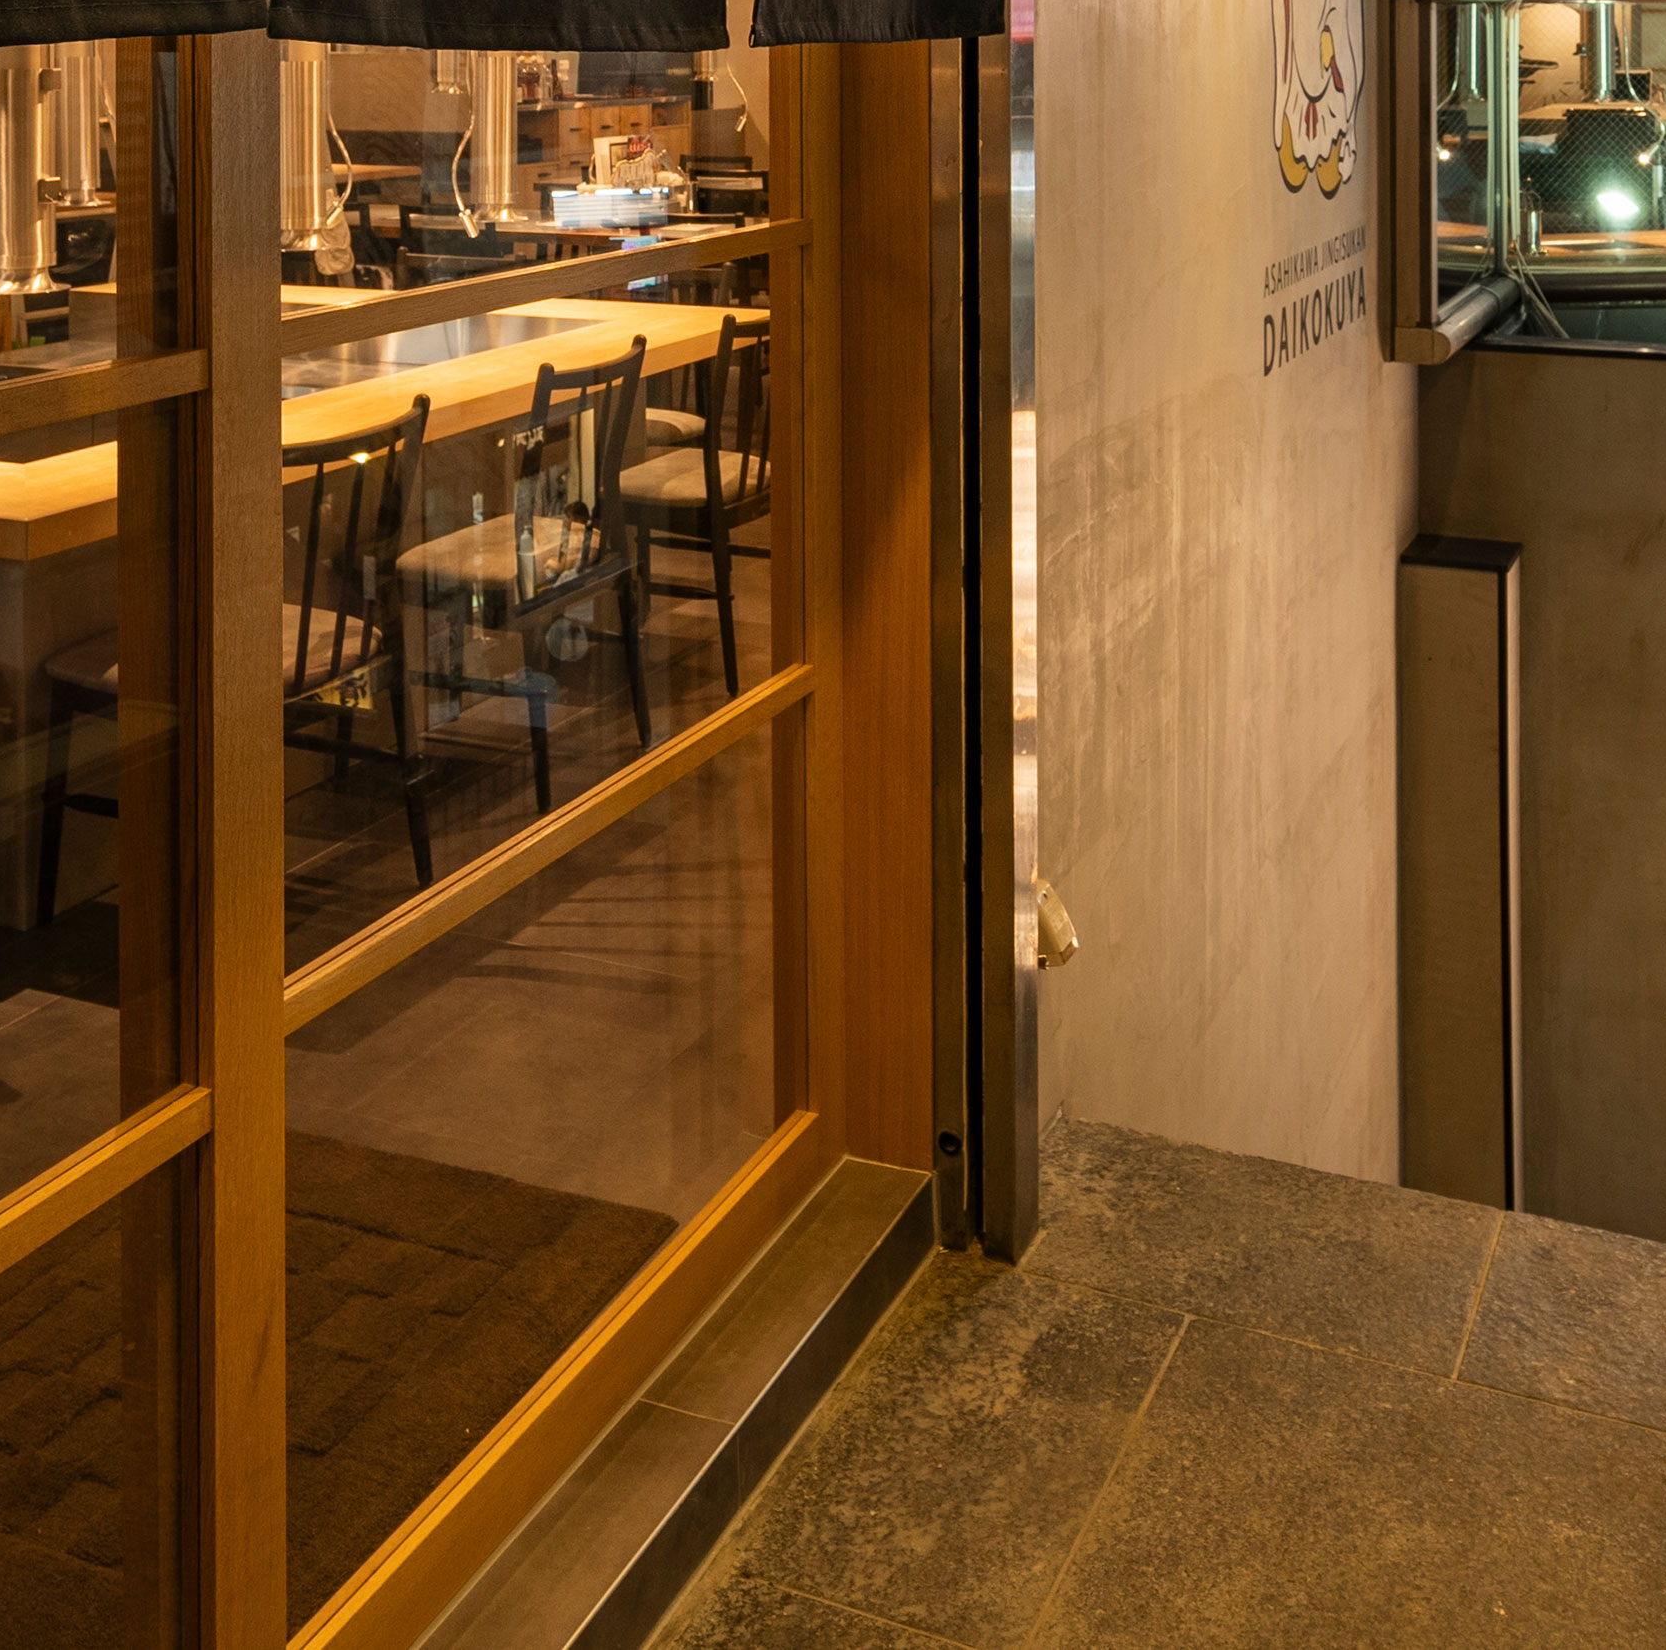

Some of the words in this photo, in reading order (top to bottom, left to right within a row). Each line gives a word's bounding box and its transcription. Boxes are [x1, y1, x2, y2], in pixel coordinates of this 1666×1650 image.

[1263, 245, 1319, 299] ASAHIKAWA
[1321, 225, 1367, 272] JINGISUKAN
[1263, 265, 1367, 377] DAIKOKUYA
